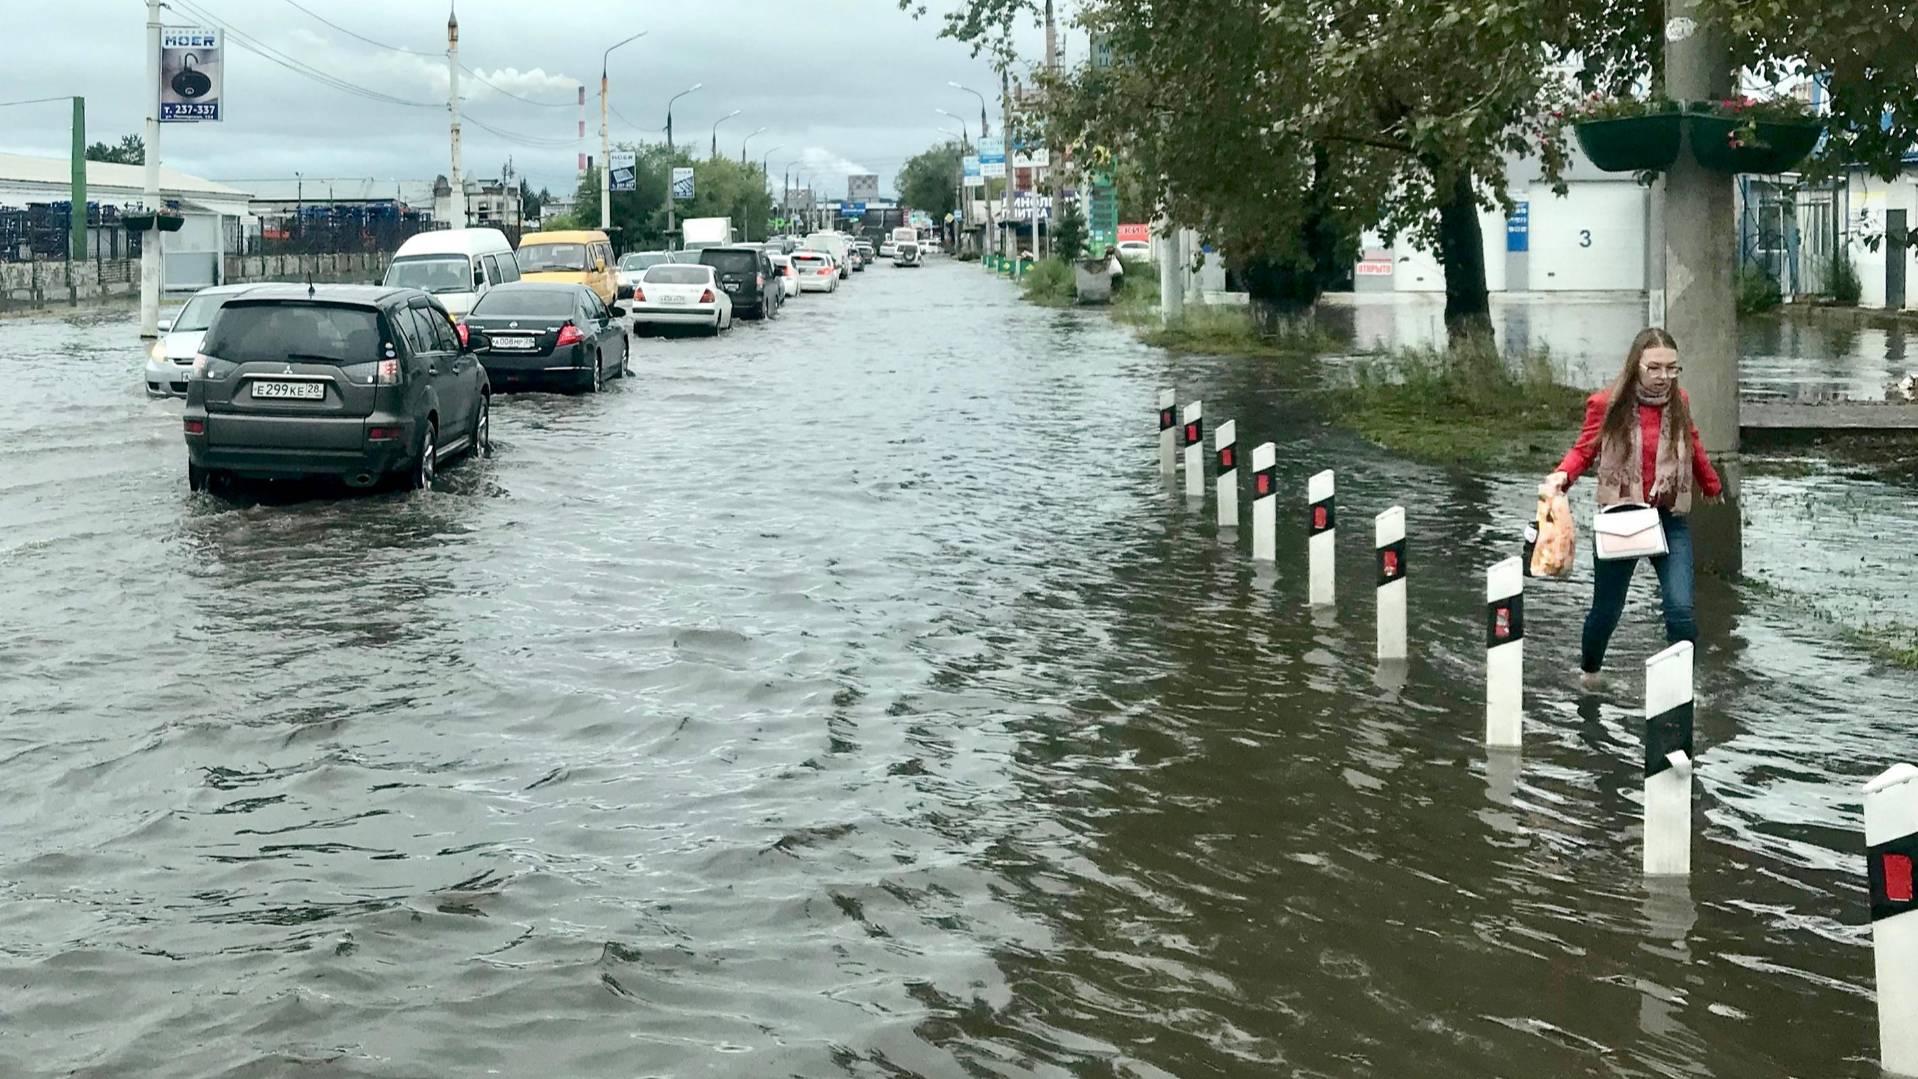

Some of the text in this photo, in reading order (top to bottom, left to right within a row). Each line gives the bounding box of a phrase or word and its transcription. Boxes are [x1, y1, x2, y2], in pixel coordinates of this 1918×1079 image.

[165, 36, 215, 46] MOER
[175, 105, 215, 114] 237-337
[1579, 230, 1592, 248] 3
